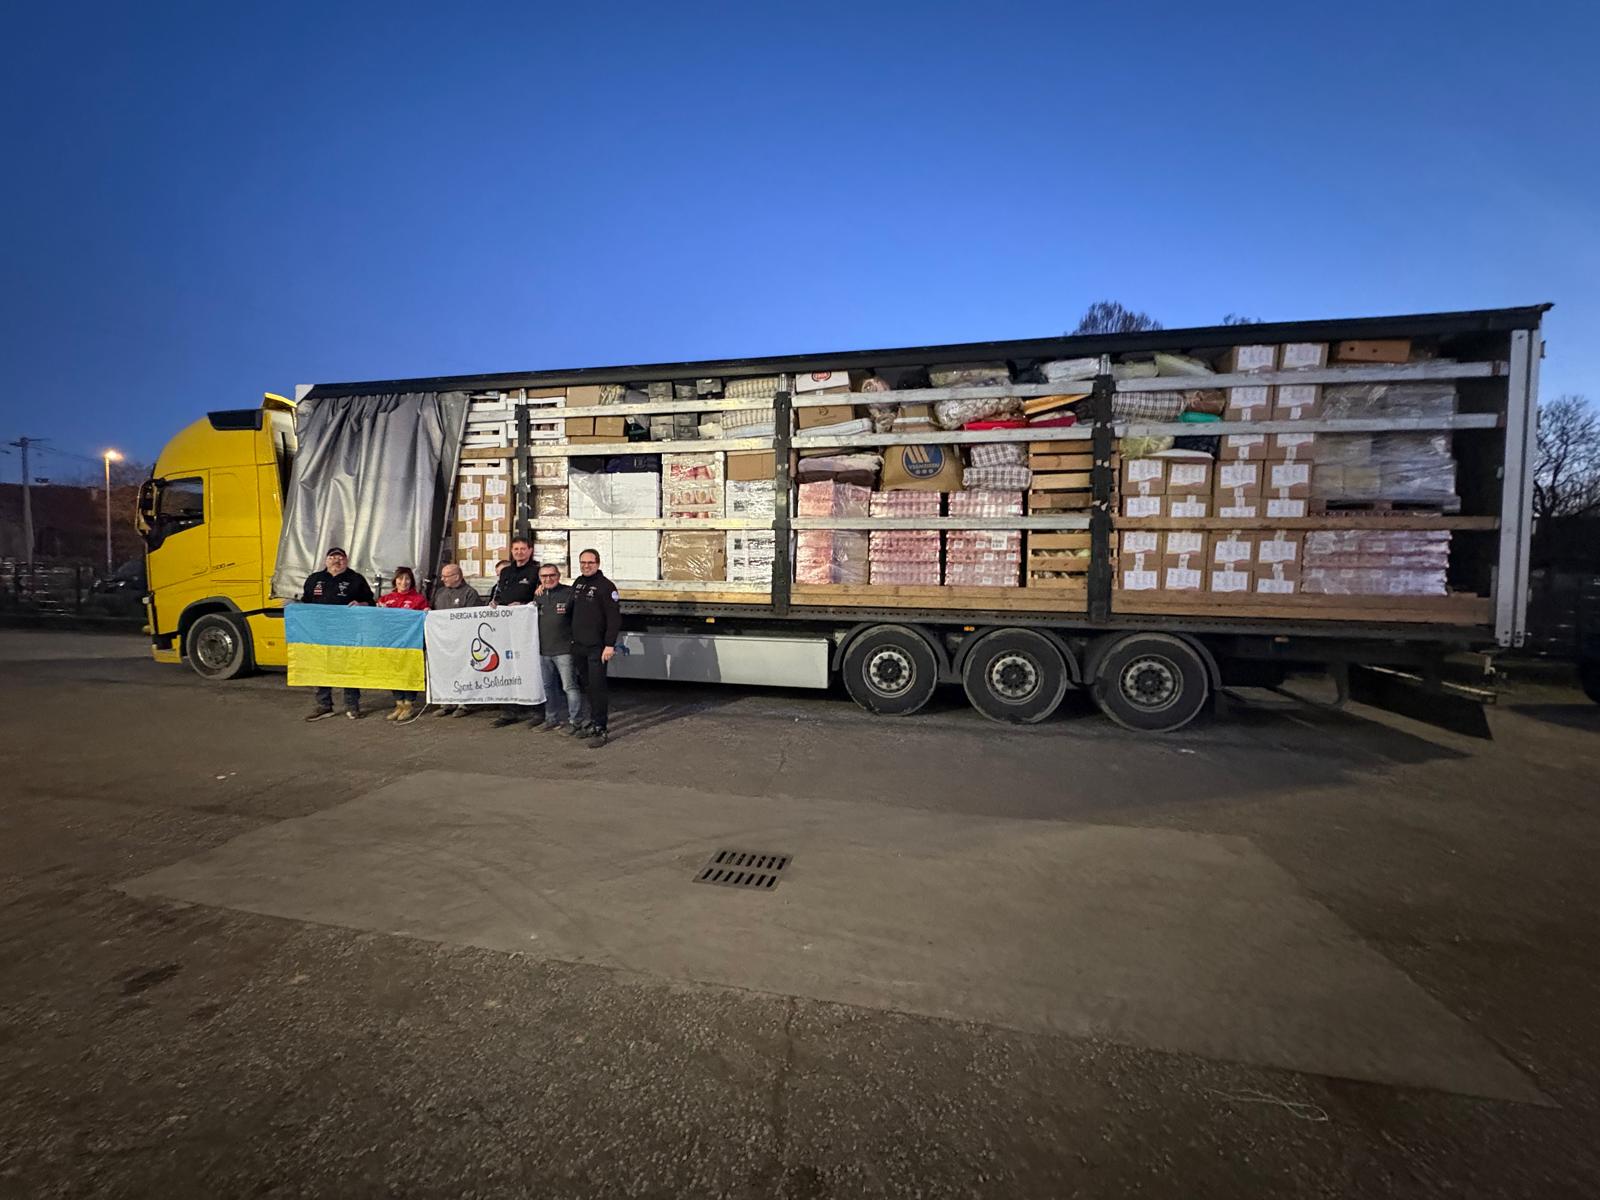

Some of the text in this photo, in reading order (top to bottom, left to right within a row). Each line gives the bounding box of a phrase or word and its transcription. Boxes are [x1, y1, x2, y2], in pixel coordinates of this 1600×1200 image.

[450, 612, 473, 621] ENERGIA
[479, 610, 500, 619] SORRISI
[452, 680, 473, 695] Sport
